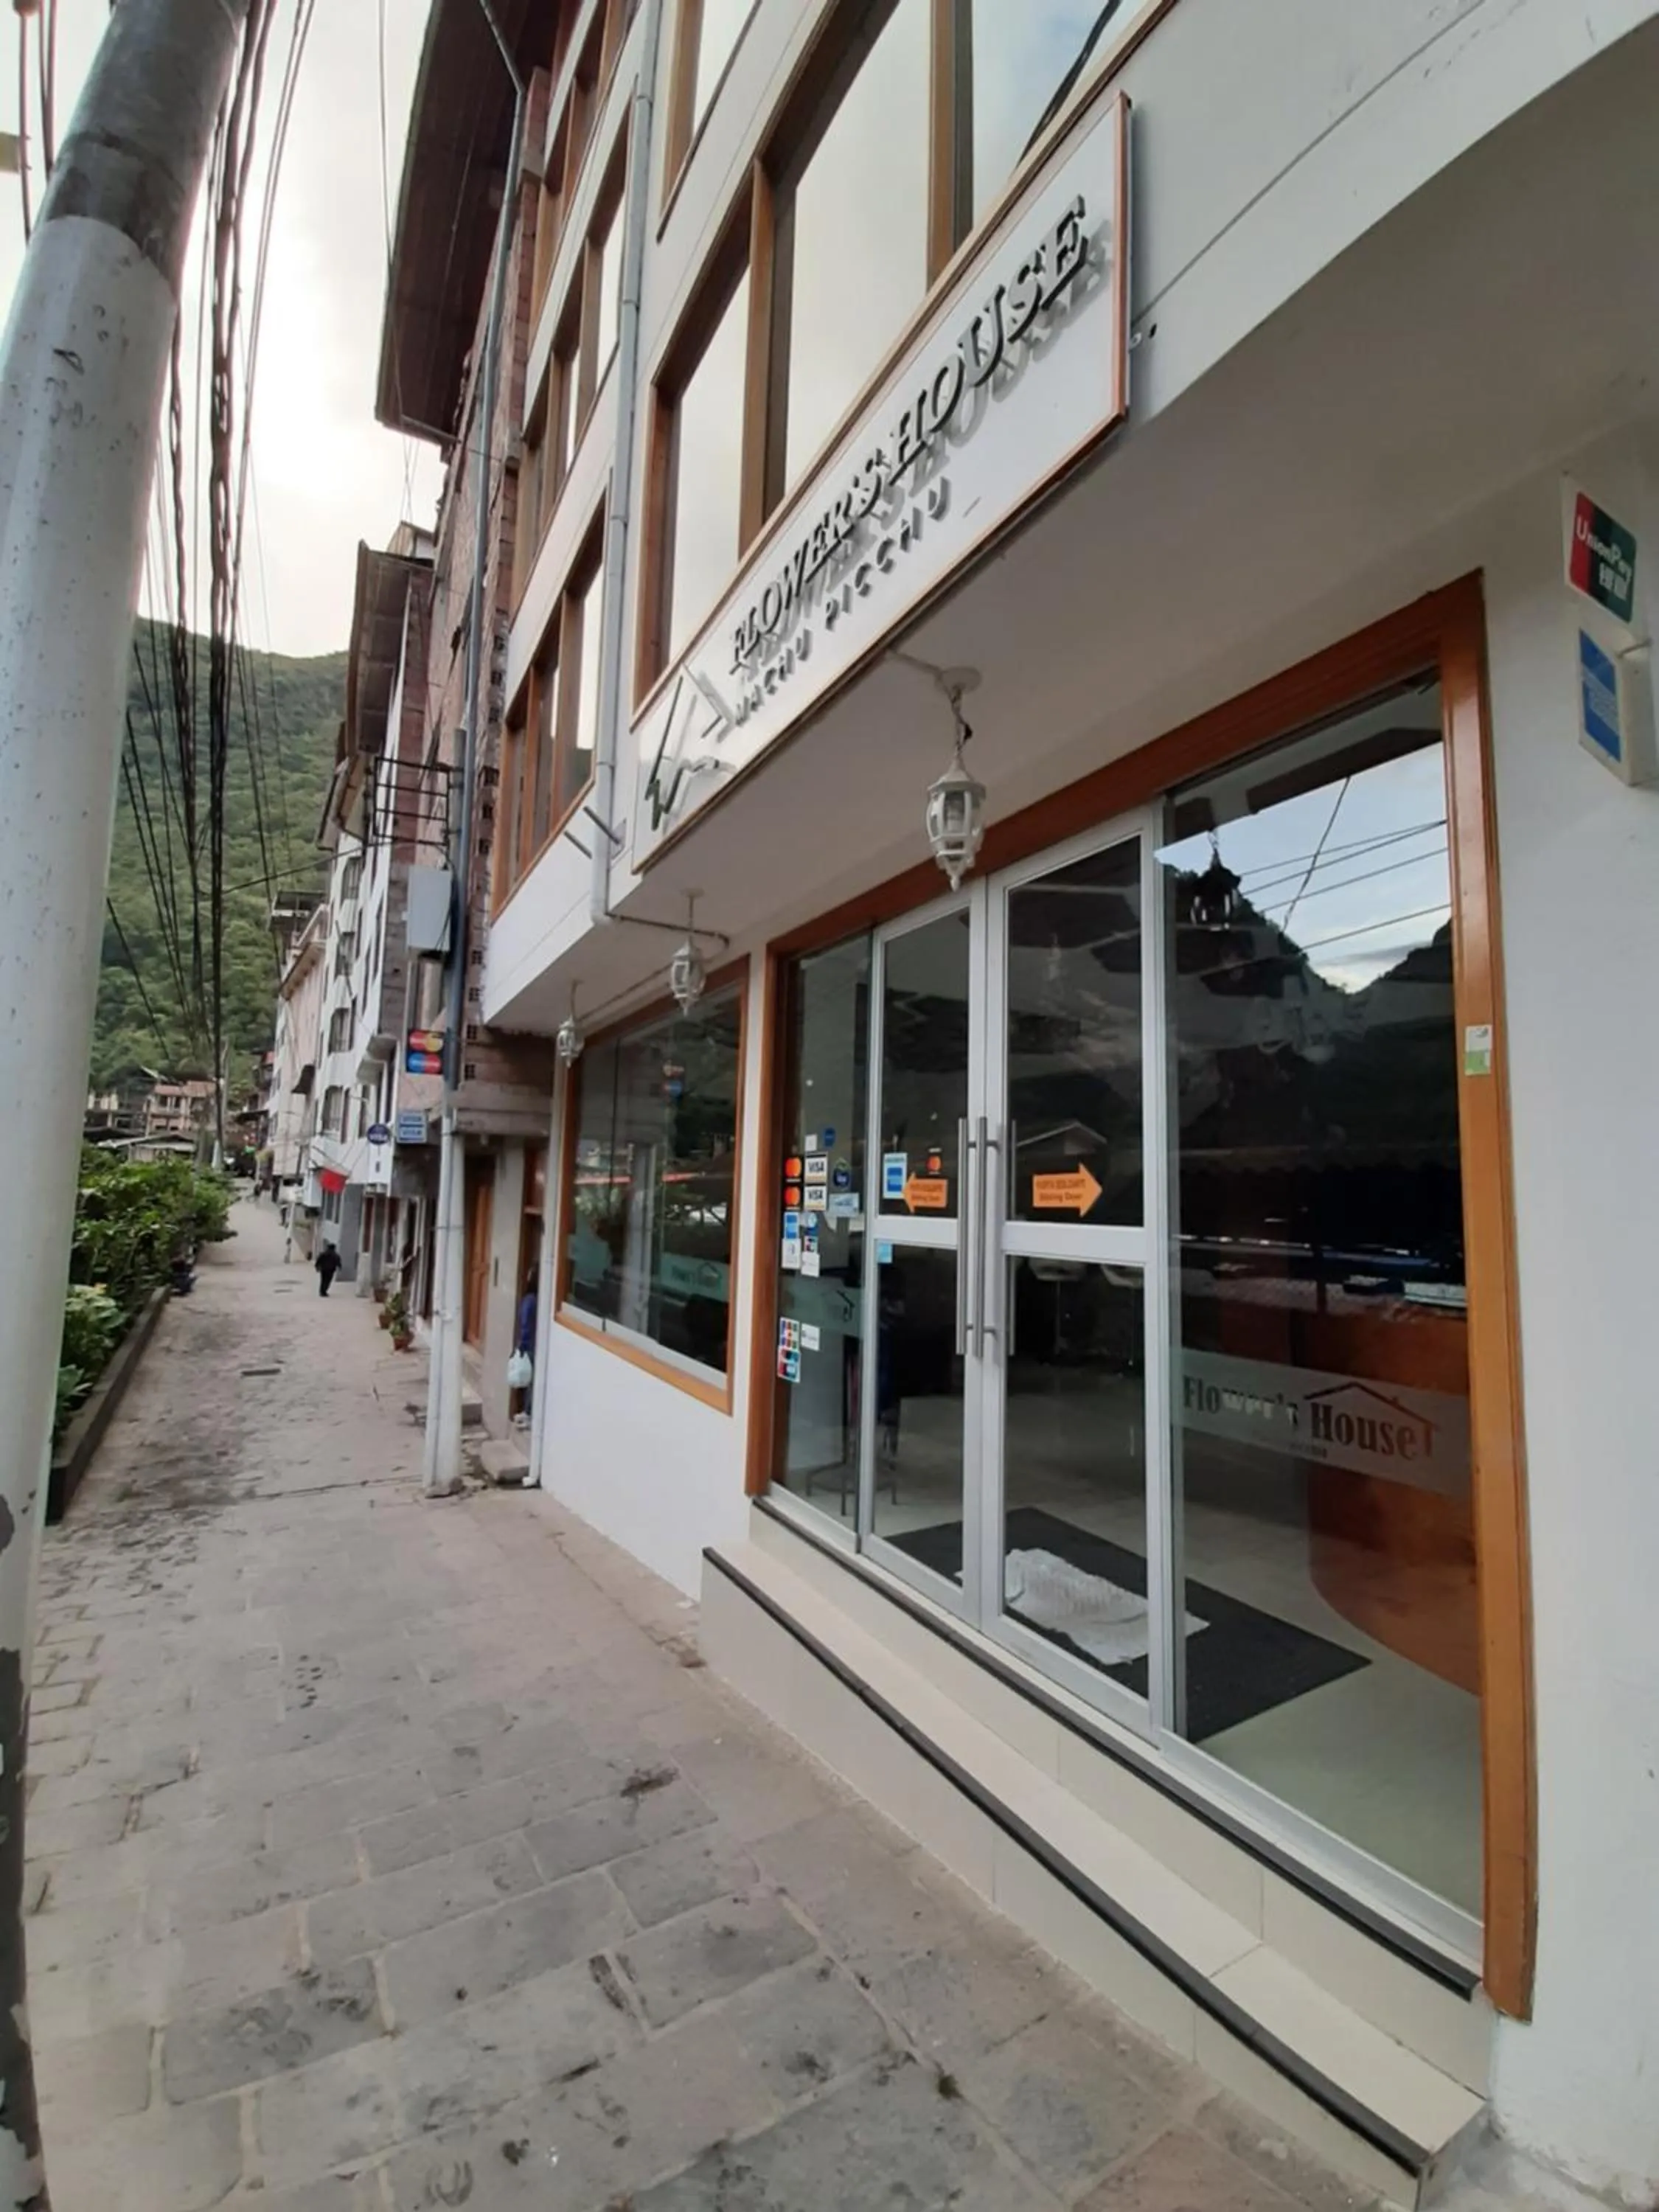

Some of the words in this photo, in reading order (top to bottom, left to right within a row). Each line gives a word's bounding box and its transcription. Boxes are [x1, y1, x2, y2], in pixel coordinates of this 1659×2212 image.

[888, 193, 1091, 487] HOUSE
[1576, 514, 1632, 582] UnionPay
[808, 1160, 824, 1173] VISA
[1312, 1402, 1418, 1459] House
